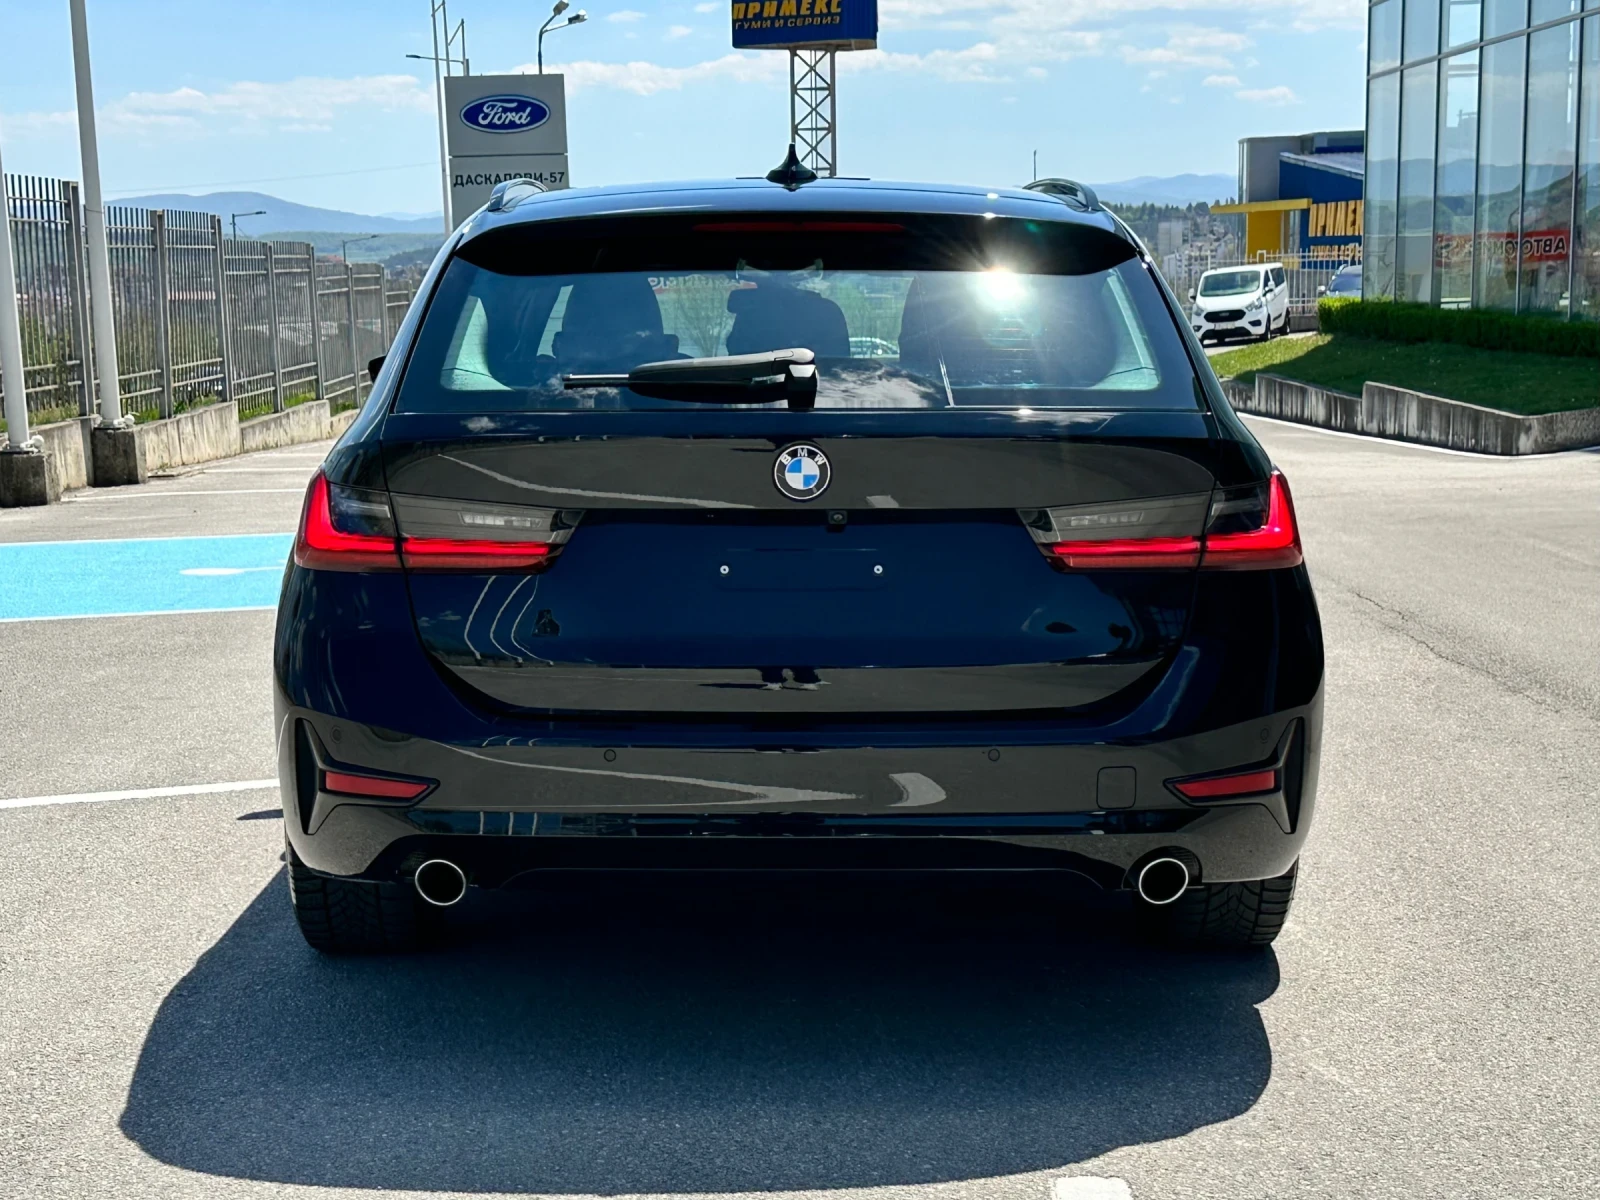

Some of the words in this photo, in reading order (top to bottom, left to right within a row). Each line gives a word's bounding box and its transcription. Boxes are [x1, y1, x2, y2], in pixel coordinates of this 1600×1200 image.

[733, 0, 841, 19] ПРИМЕКС
[735, 19, 771, 30] ГУМИ
[774, 18, 784, 28] И
[478, 101, 532, 125] Ford
[780, 447, 826, 465] BMW
